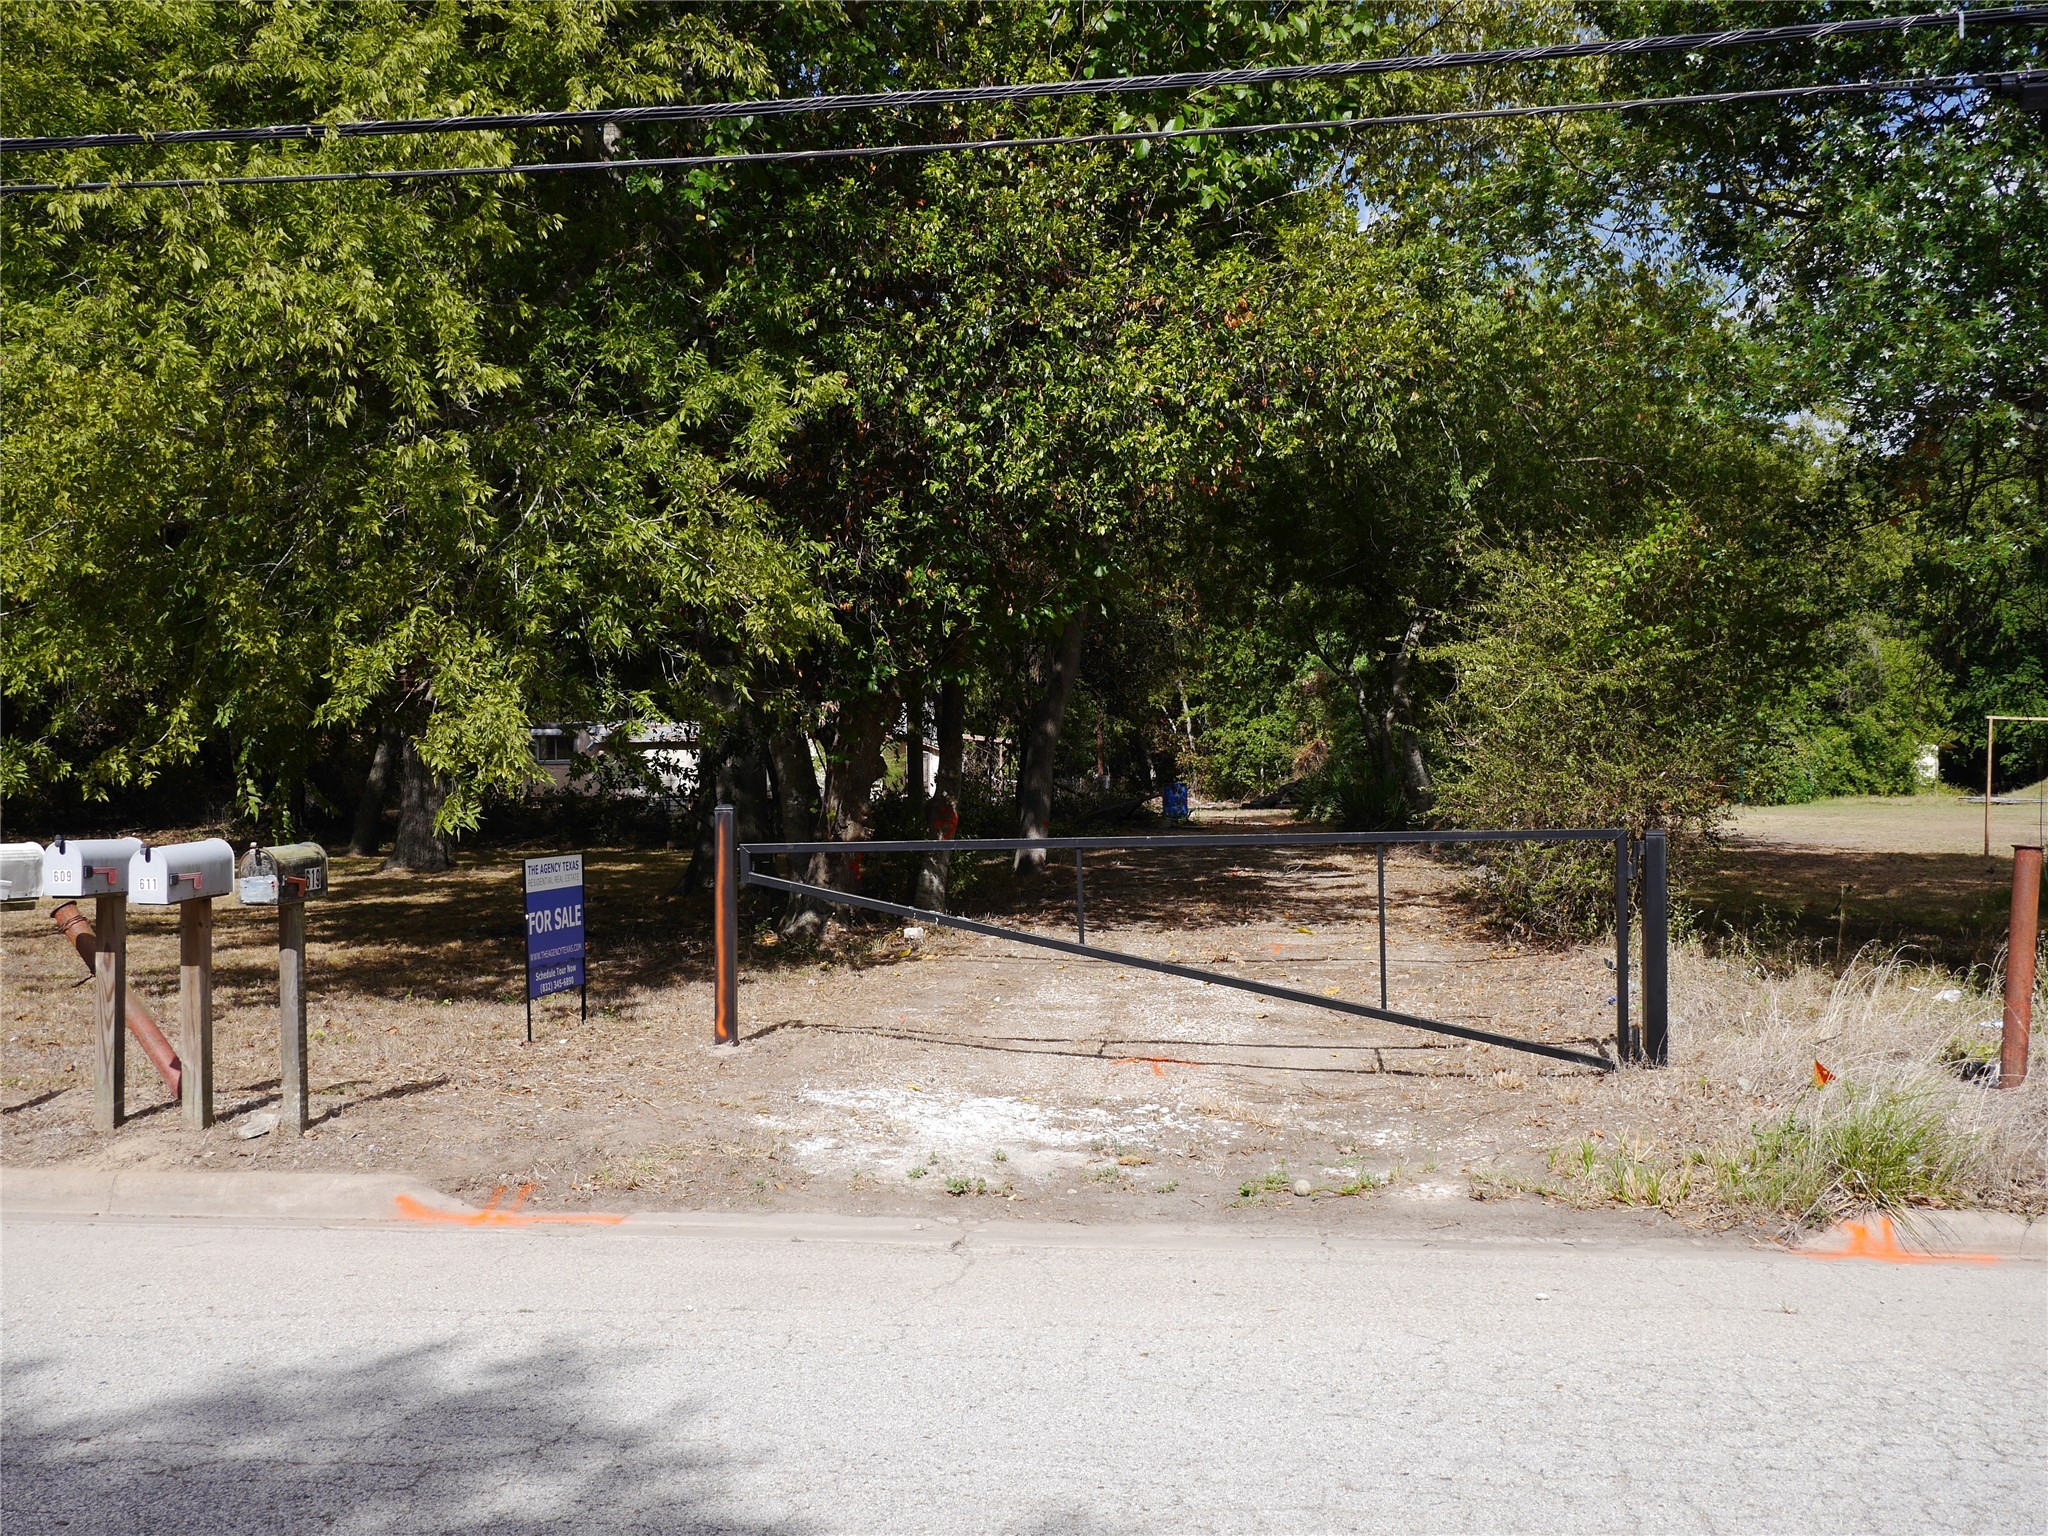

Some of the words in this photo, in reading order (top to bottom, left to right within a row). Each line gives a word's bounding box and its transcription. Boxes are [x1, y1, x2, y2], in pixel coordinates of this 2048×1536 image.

[528, 864, 539, 876] THE
[540, 862, 561, 874] AGENCY
[562, 860, 579, 872] TEXAS
[53, 870, 72, 882] 609
[305, 868, 321, 890] 619
[528, 876, 554, 887] RESIDENTIAL
[554, 874, 564, 884] REAL
[564, 872, 580, 883] ESTATE
[139, 878, 157, 890] 611
[529, 910, 553, 936] FOR
[554, 904, 582, 930] SALE
[535, 969, 556, 981] Schedule
[556, 967, 567, 976] Tour
[566, 964, 577, 974] Now
[540, 982, 553, 994] (832)
